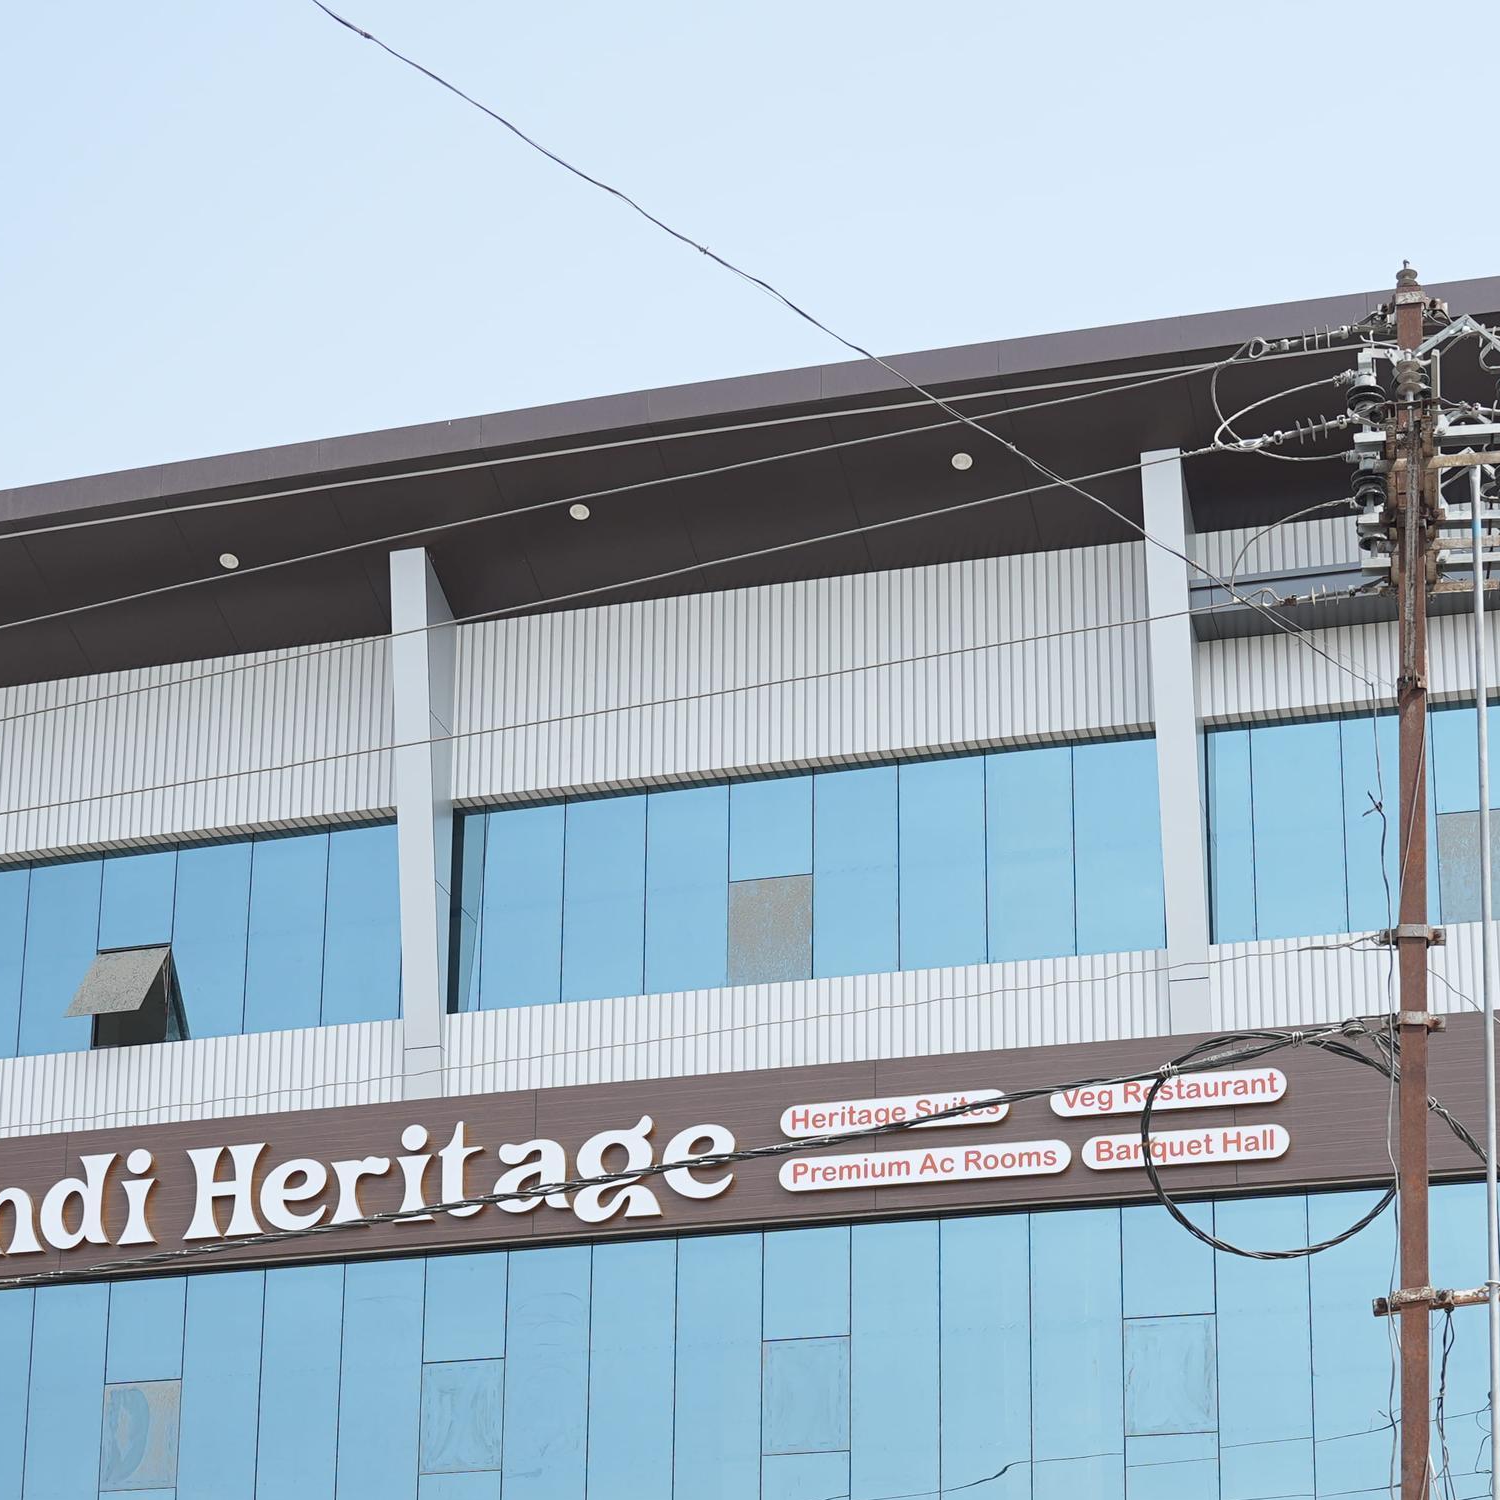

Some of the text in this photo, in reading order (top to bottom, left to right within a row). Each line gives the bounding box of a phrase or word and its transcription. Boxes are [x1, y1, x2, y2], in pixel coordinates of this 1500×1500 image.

[1062, 1087, 1113, 1111] Veg
[791, 1105, 906, 1130] Heritage
[1222, 1129, 1275, 1154] Hall
[183, 1115, 737, 1241] Heritage
[792, 1149, 1057, 1185] Premium Ac Rooms
